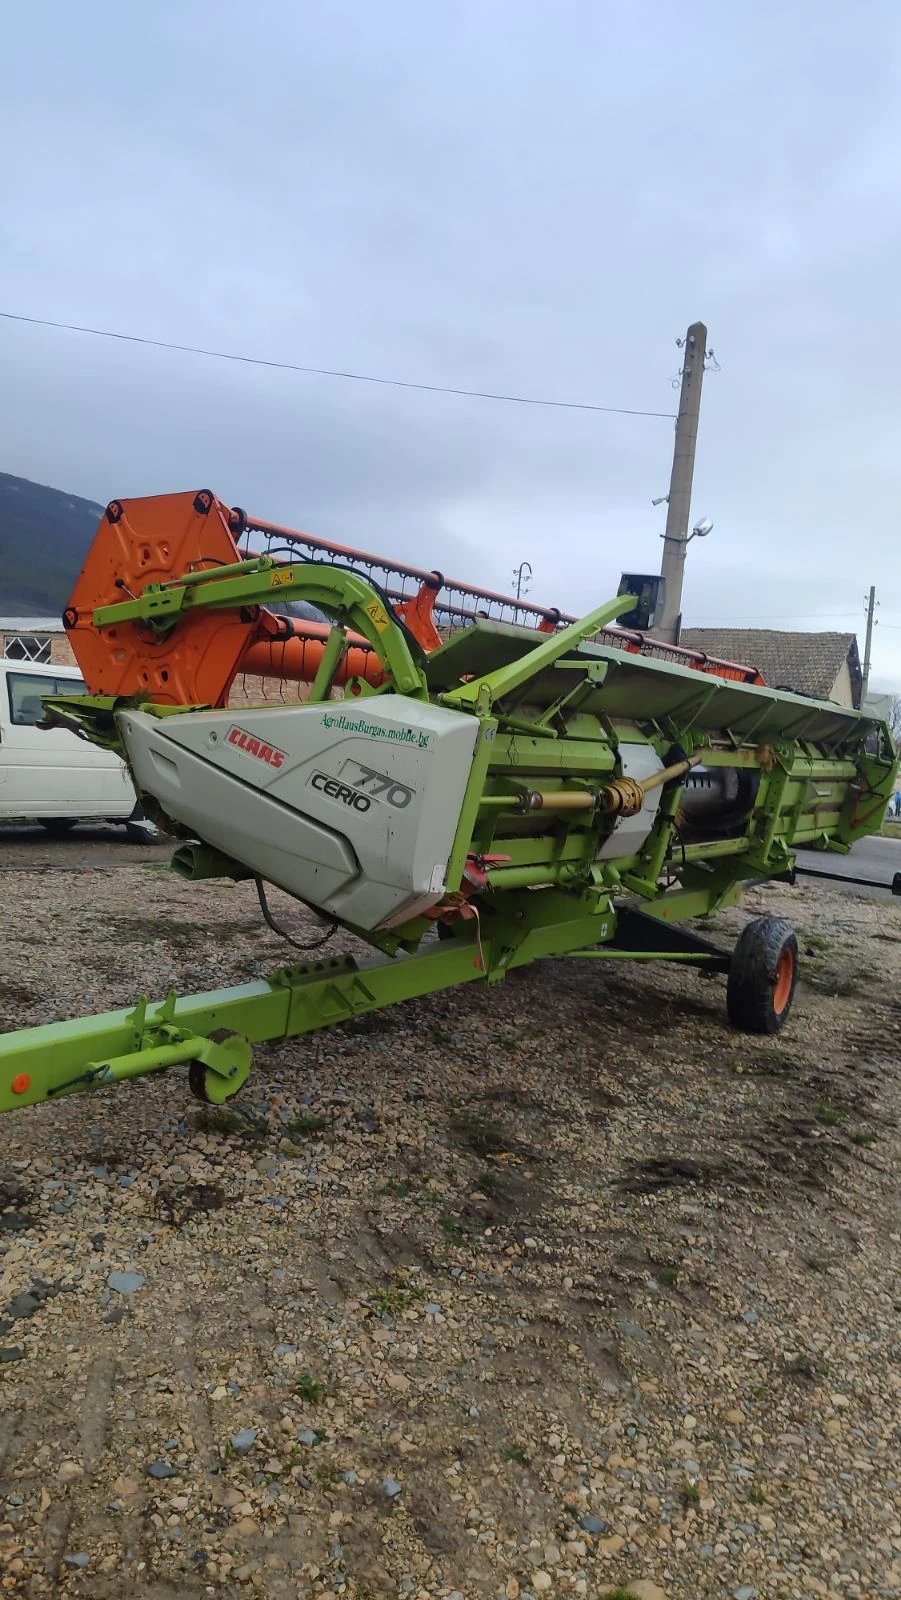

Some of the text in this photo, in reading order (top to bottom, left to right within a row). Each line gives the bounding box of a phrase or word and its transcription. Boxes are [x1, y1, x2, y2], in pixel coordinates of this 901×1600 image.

[227, 729, 285, 769] CLAAS
[320, 713, 429, 748] AgroHausBurgas.mobile.bg
[311, 774, 371, 813] CERIO
[352, 766, 412, 809] 770
